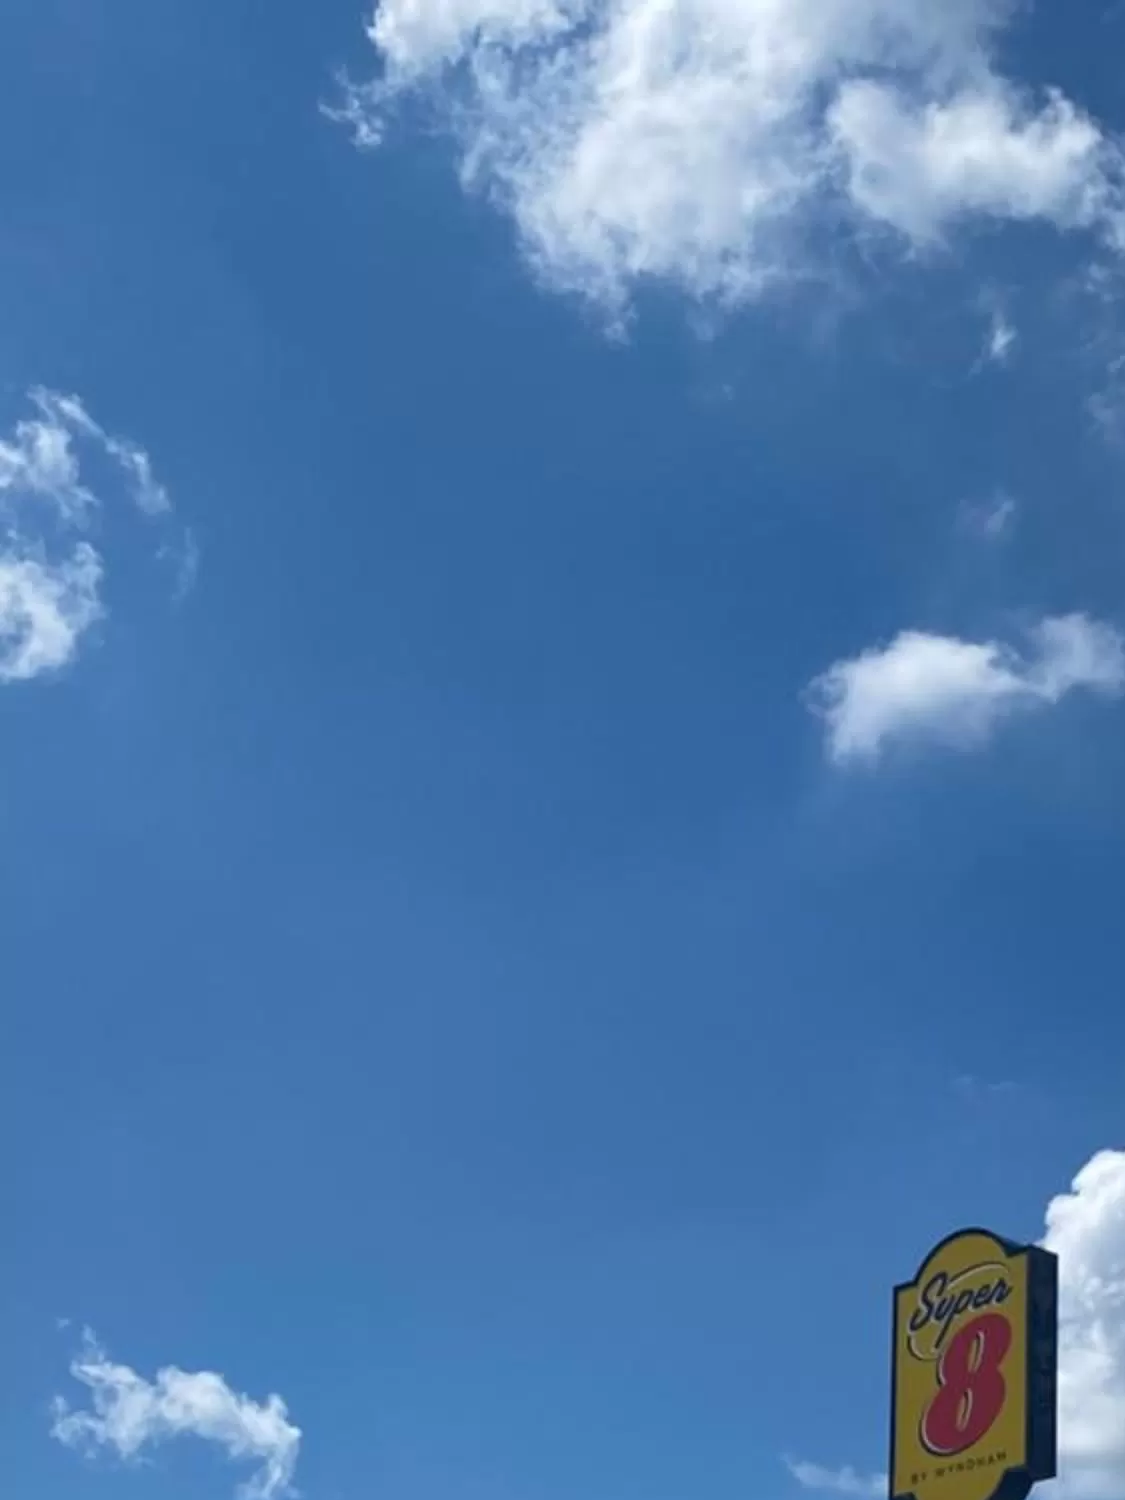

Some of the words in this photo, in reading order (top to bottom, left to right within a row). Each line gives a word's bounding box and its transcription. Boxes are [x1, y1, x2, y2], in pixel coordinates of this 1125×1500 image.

[908, 1264, 1013, 1354] Super
[919, 1312, 1013, 1457] 8
[911, 1470, 927, 1485] BY
[935, 1450, 1007, 1477] WYNDHAM
